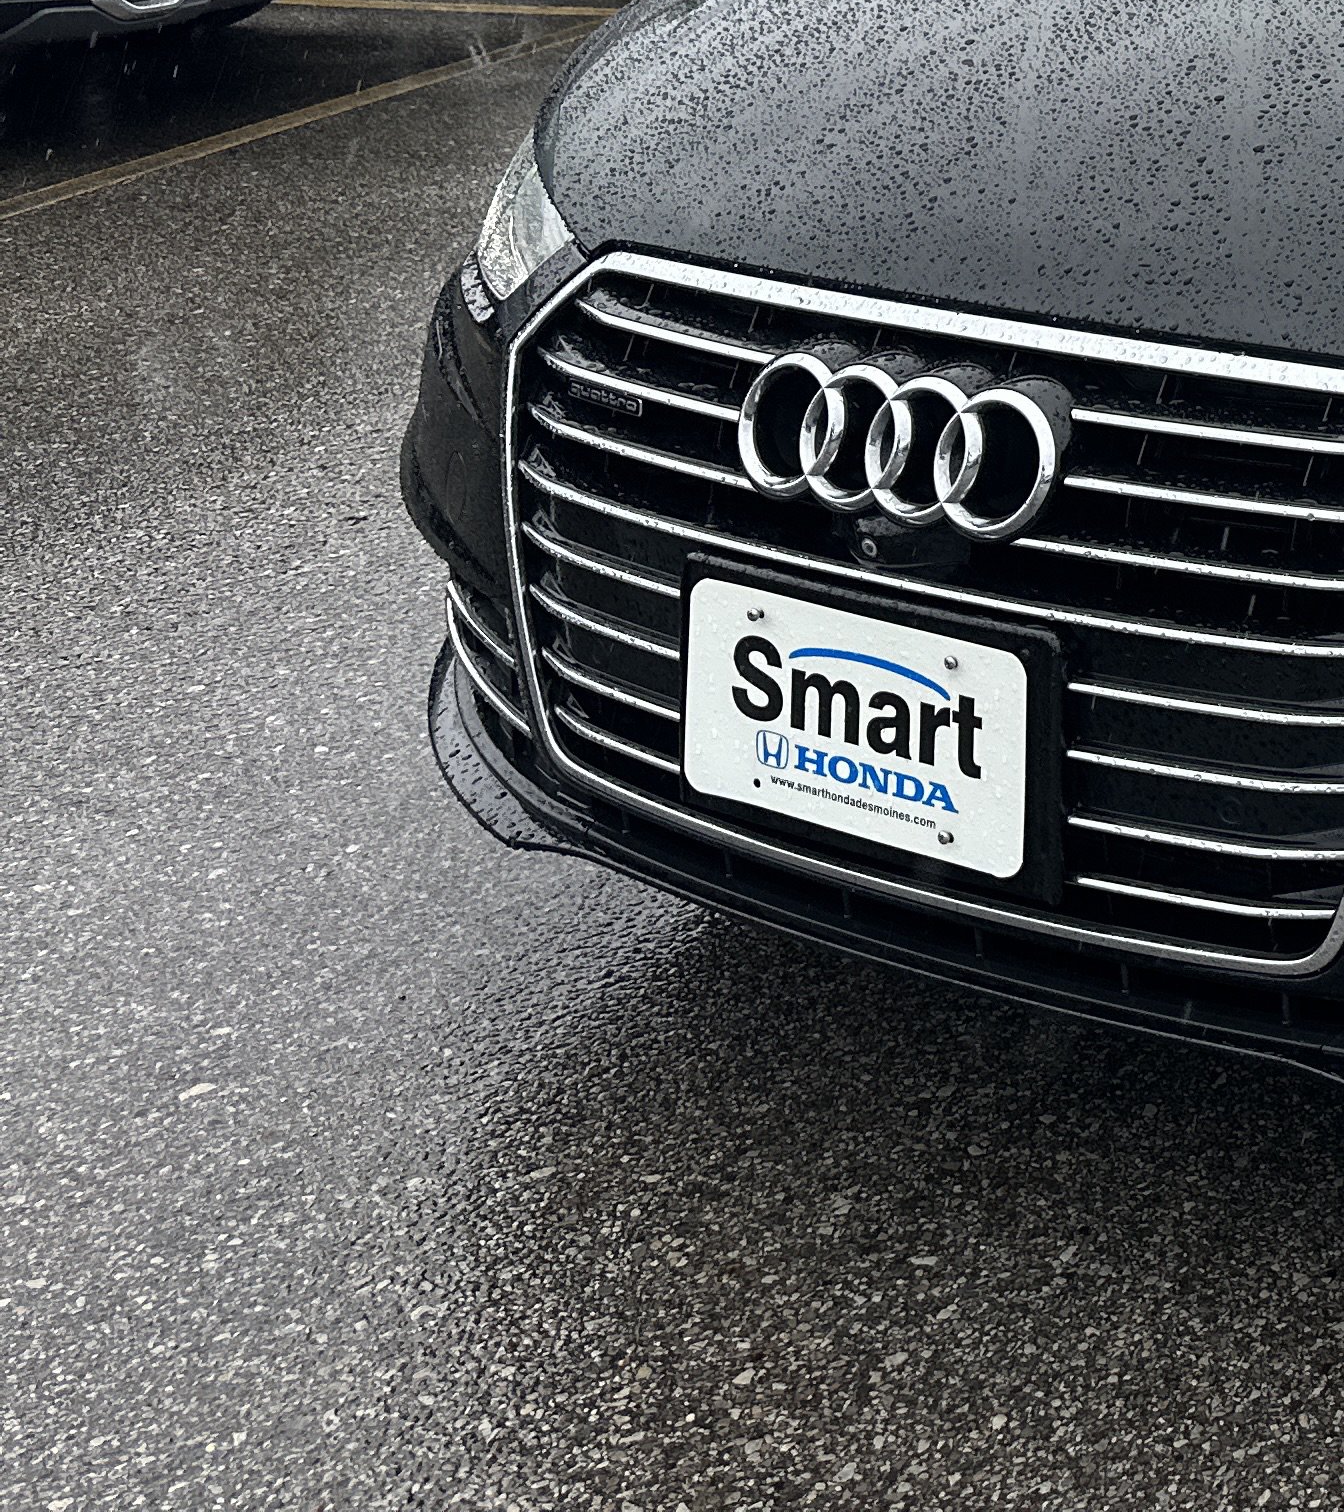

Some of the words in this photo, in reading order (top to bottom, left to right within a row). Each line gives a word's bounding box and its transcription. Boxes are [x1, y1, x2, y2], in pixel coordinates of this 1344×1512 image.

[570, 381, 638, 412] quattro
[731, 634, 983, 781] Smart
[769, 773, 937, 830] www.smarthondadesmoines.com
[793, 743, 960, 815] HONDA
